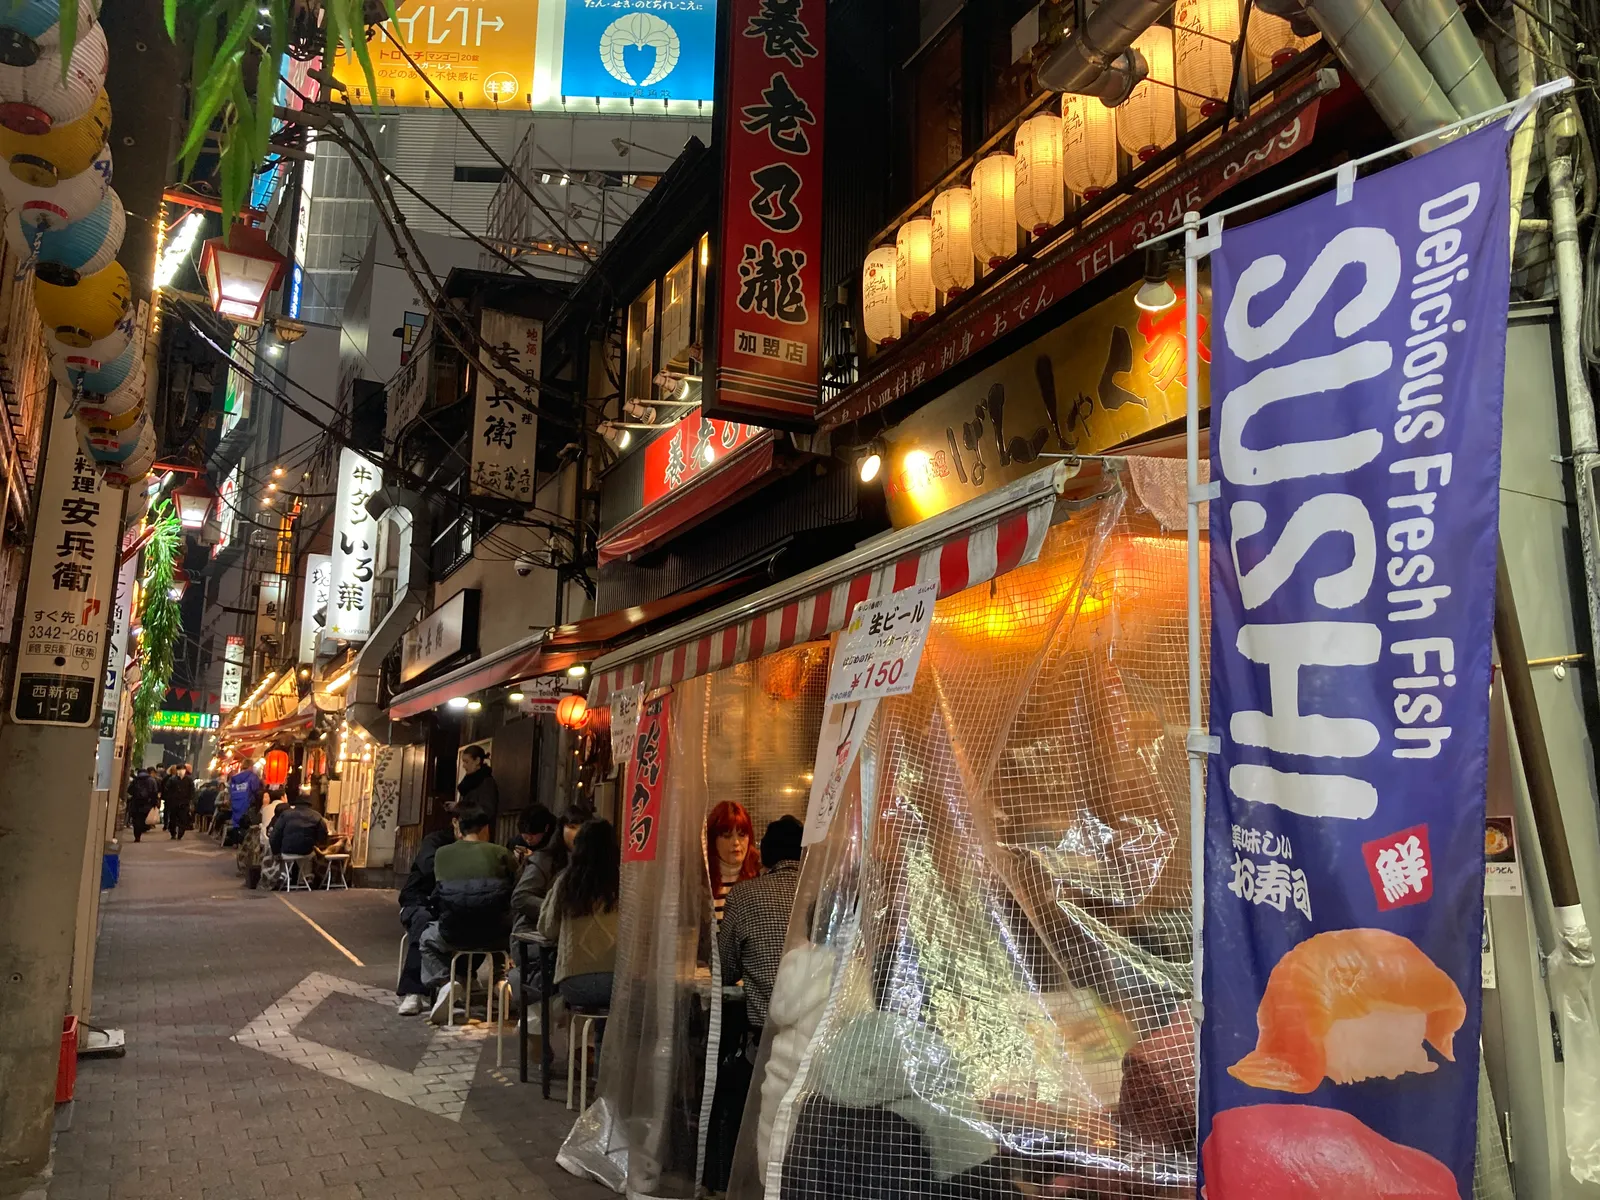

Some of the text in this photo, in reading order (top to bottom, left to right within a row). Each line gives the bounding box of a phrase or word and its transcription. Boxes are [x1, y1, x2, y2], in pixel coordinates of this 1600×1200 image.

[407, 62, 452, 70] シガーレス
[428, 53, 457, 61] マンゴー
[460, 54, 480, 62] 20錠
[377, 69, 479, 82] のどのあ・不快感に
[486, 80, 515, 94] 生薬
[1076, 240, 1126, 283] TEL
[737, 330, 805, 364] 加盟店
[1386, 180, 1483, 761] Delicious Fresh Fish
[351, 465, 373, 526] 牛タン
[1218, 226, 1402, 821] SUSHI
[51, 497, 100, 593] 安兵衛
[337, 530, 374, 612] いろ葉
[28, 625, 99, 644] 3342-2661
[33, 610, 76, 624] すぐ先
[868, 600, 925, 636] 生ビール
[74, 646, 95, 657] 検索
[32, 684, 80, 700] 西新宿
[850, 657, 904, 692] ¥150
[36, 701, 71, 716] 1-2
[1231, 823, 1293, 860] 美味しい
[1375, 834, 1429, 903] 鮮
[1227, 851, 1312, 922] お寿司
